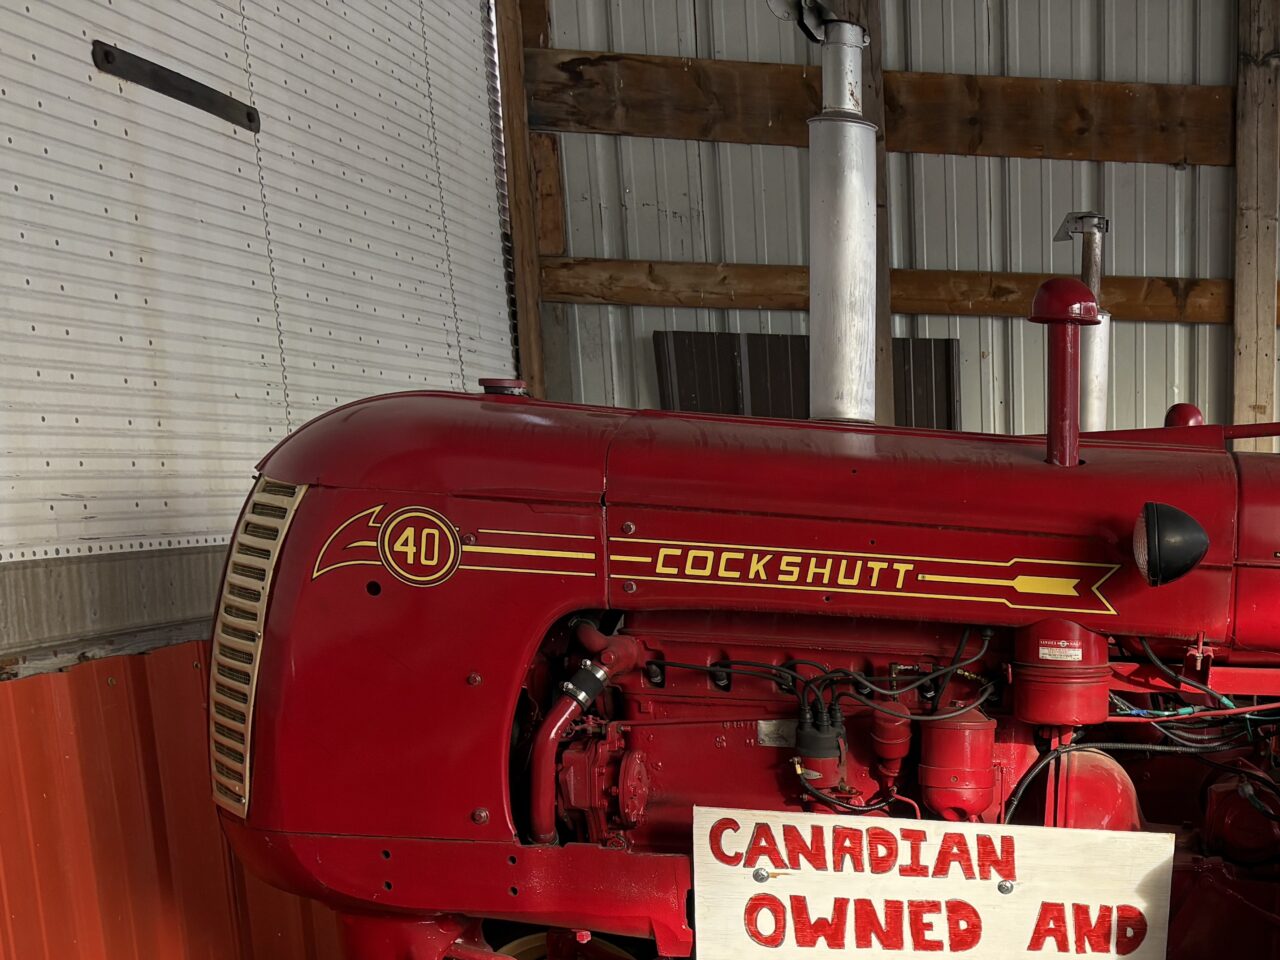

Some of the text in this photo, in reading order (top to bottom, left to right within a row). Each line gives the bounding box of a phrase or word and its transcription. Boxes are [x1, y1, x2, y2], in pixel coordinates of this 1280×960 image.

[393, 527, 441, 568] 40
[655, 547, 916, 589] COCKSHUTT
[709, 817, 1017, 882] CANADIAN
[744, 893, 1149, 956] OWNED AND
